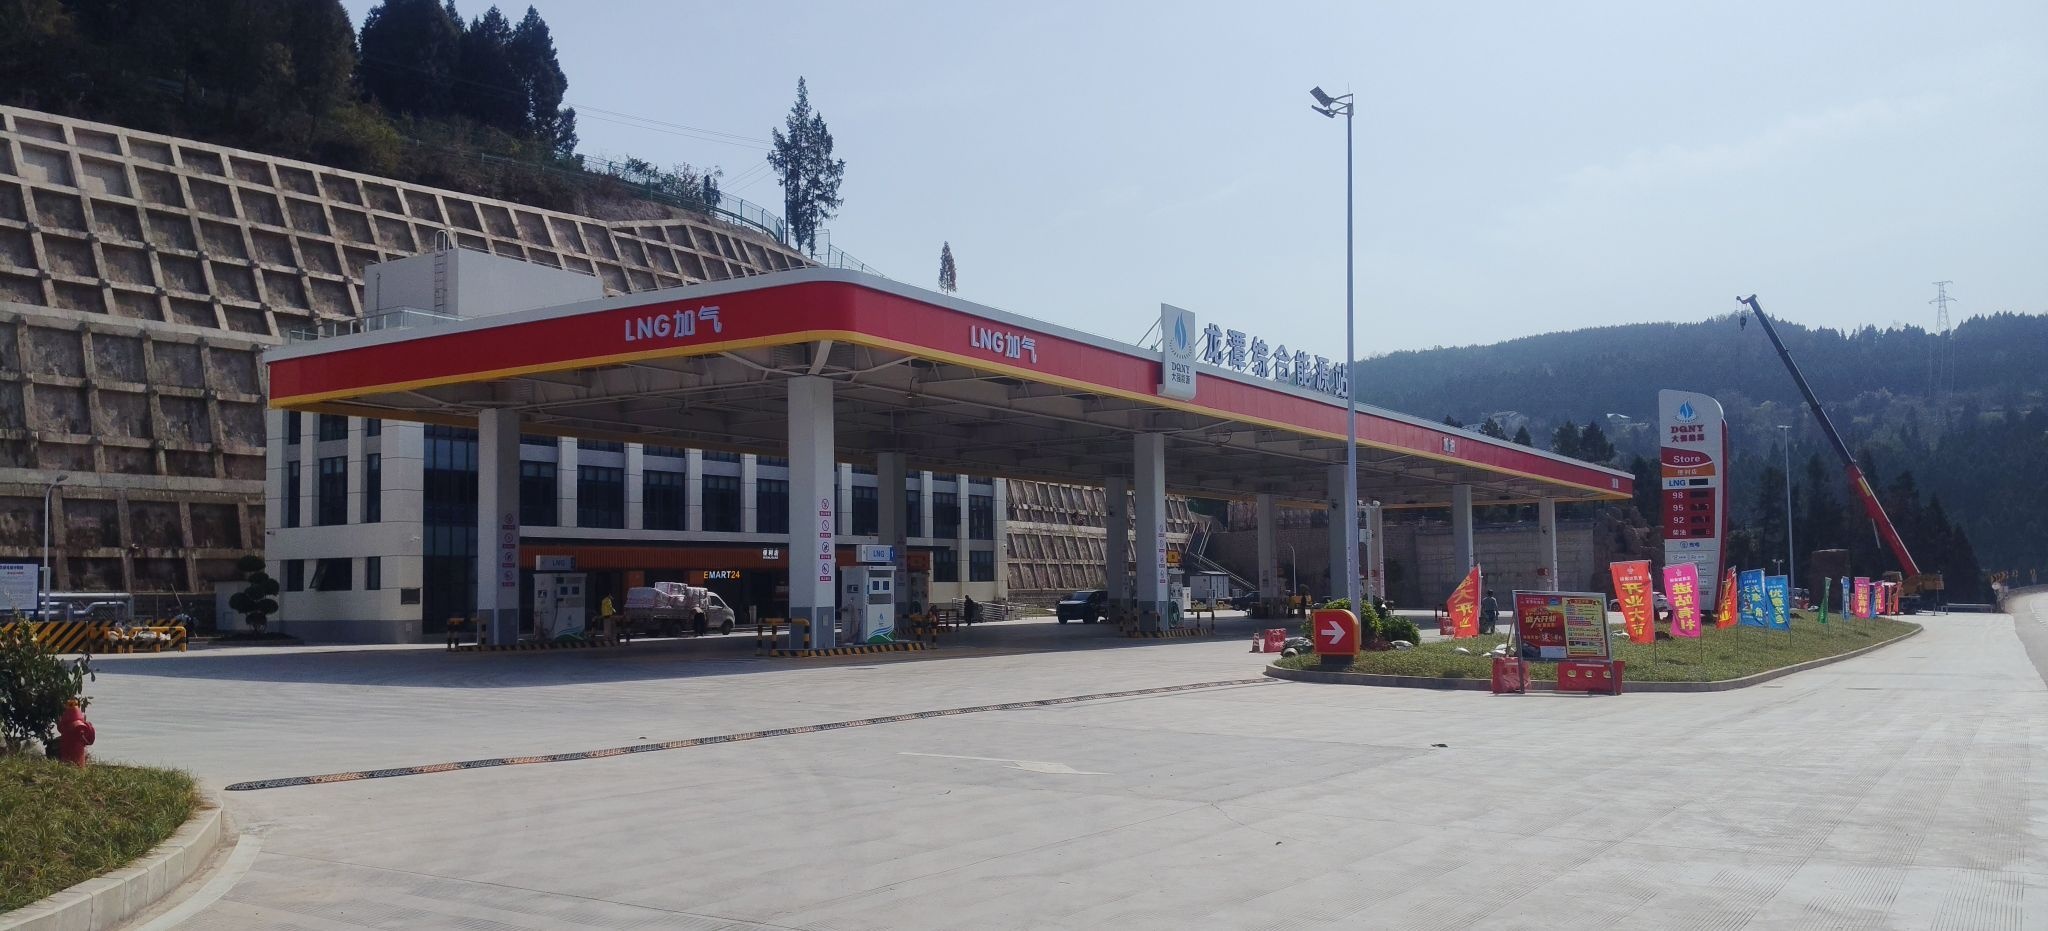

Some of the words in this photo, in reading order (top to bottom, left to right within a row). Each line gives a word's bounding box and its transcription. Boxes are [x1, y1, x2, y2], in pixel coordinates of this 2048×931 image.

[625, 305, 722, 342] LNG加气
[970, 325, 1037, 364] LNG加气
[1204, 322, 1348, 398] 龙潭综合能源站
[1673, 455, 1701, 463] Store
[1668, 479, 1686, 487] LNG
[1672, 491, 1684, 499] 98
[1672, 504, 1684, 512] 95
[1673, 516, 1685, 524] 92
[873, 550, 885, 558] LNG
[703, 570, 741, 579] EMART24
